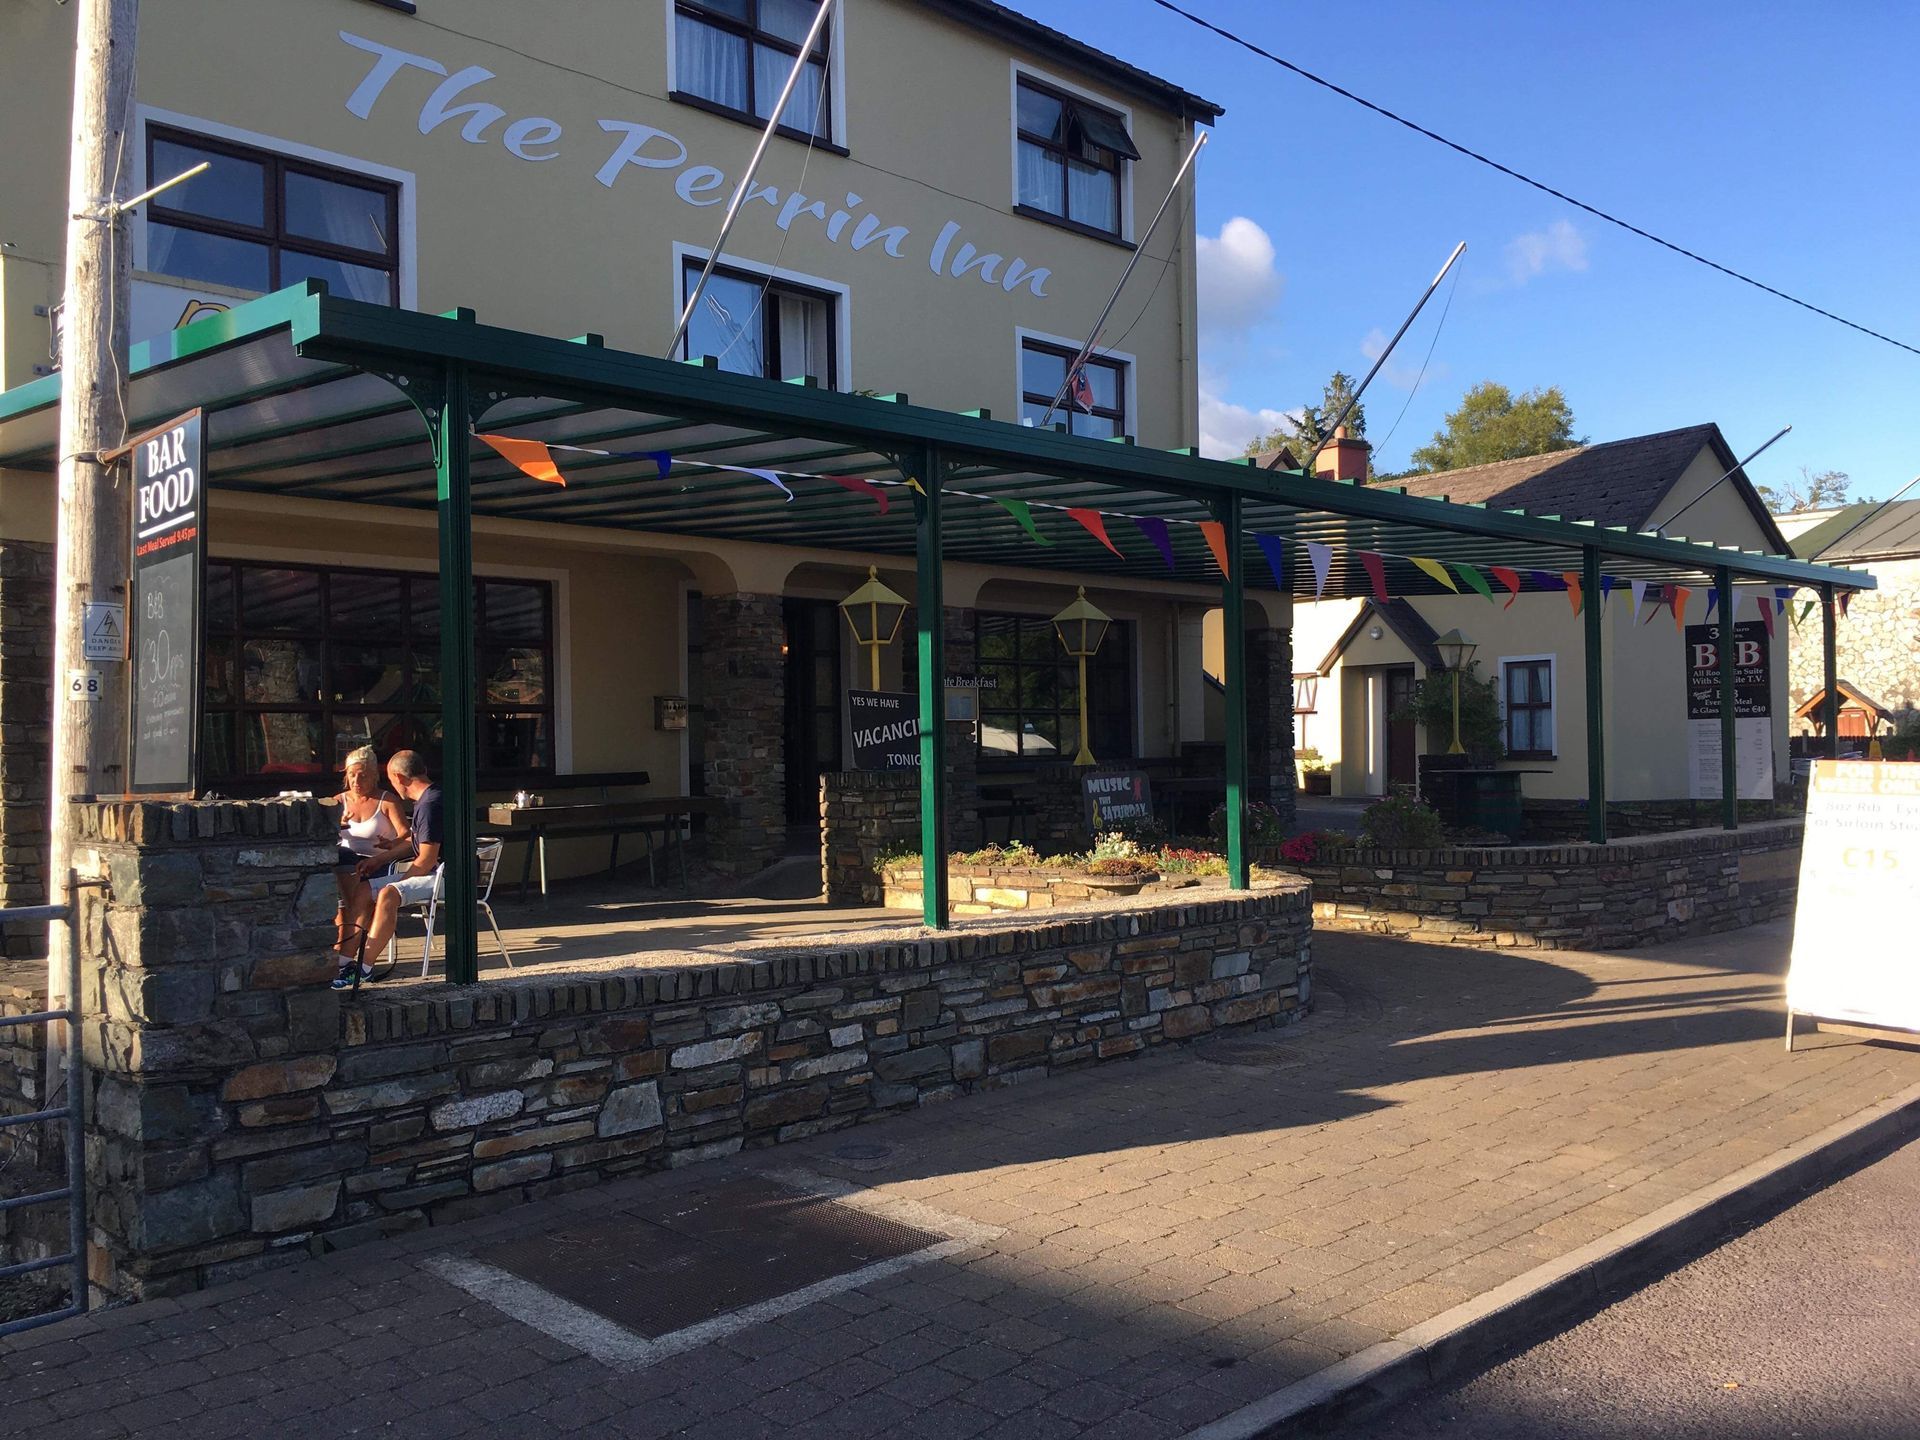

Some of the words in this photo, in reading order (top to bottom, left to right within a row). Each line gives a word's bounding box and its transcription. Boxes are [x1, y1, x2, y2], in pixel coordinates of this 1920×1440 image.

[339, 30, 562, 162] The
[594, 119, 911, 260] Perrin
[929, 220, 1053, 298] Inn
[147, 427, 187, 478] BAR
[139, 467, 195, 524] FOOD
[136, 544, 148, 556] Last
[147, 537, 160, 552] Meal
[159, 531, 177, 549] Served
[1743, 667, 1764, 675] Suite
[955, 676, 997, 689] Breakfast
[1692, 677, 1712, 685] With
[1747, 675, 1765, 684] T.V.
[851, 696, 865, 707] YES
[866, 697, 879, 708] WE
[880, 698, 900, 709] HAVE
[1700, 706, 1720, 714] Glass
[887, 753, 922, 767] TONIG
[1835, 763, 1875, 778] FOR
[1087, 776, 1131, 794] MUSIC
[1818, 778, 1873, 792] WEEK
[1879, 780, 1920, 794] ONL
[1101, 802, 1147, 821] SATURDAY
